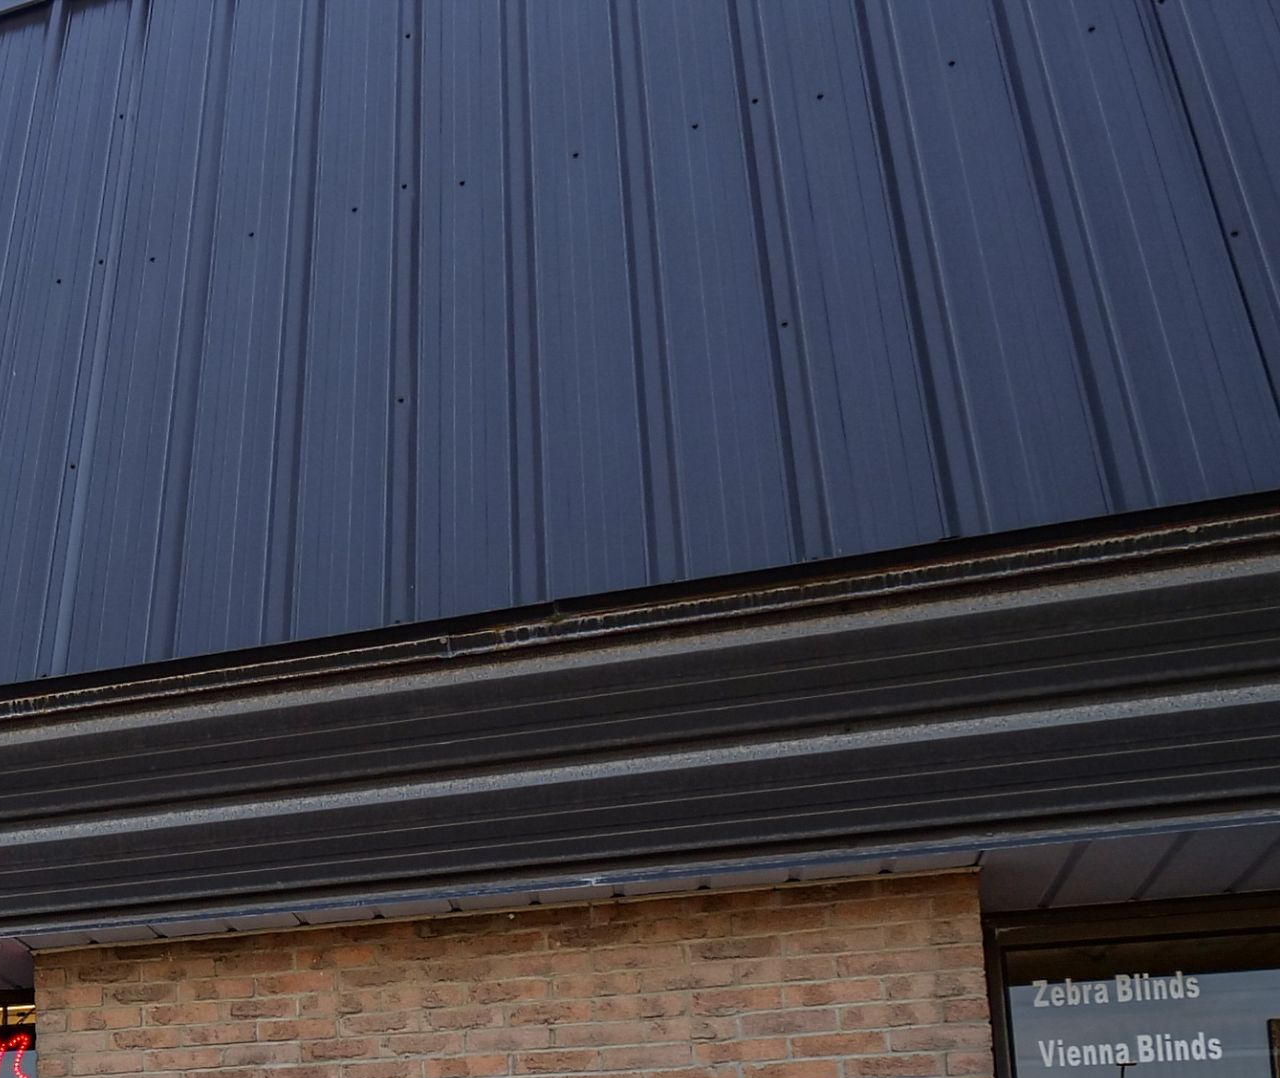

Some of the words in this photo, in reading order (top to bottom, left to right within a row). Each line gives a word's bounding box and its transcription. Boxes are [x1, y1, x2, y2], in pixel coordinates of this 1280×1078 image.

[1032, 978, 1109, 1008] Zebra
[1115, 971, 1200, 1003] Blinds
[1038, 1039, 1130, 1068] Vienna
[1136, 1031, 1223, 1063] Blinds
